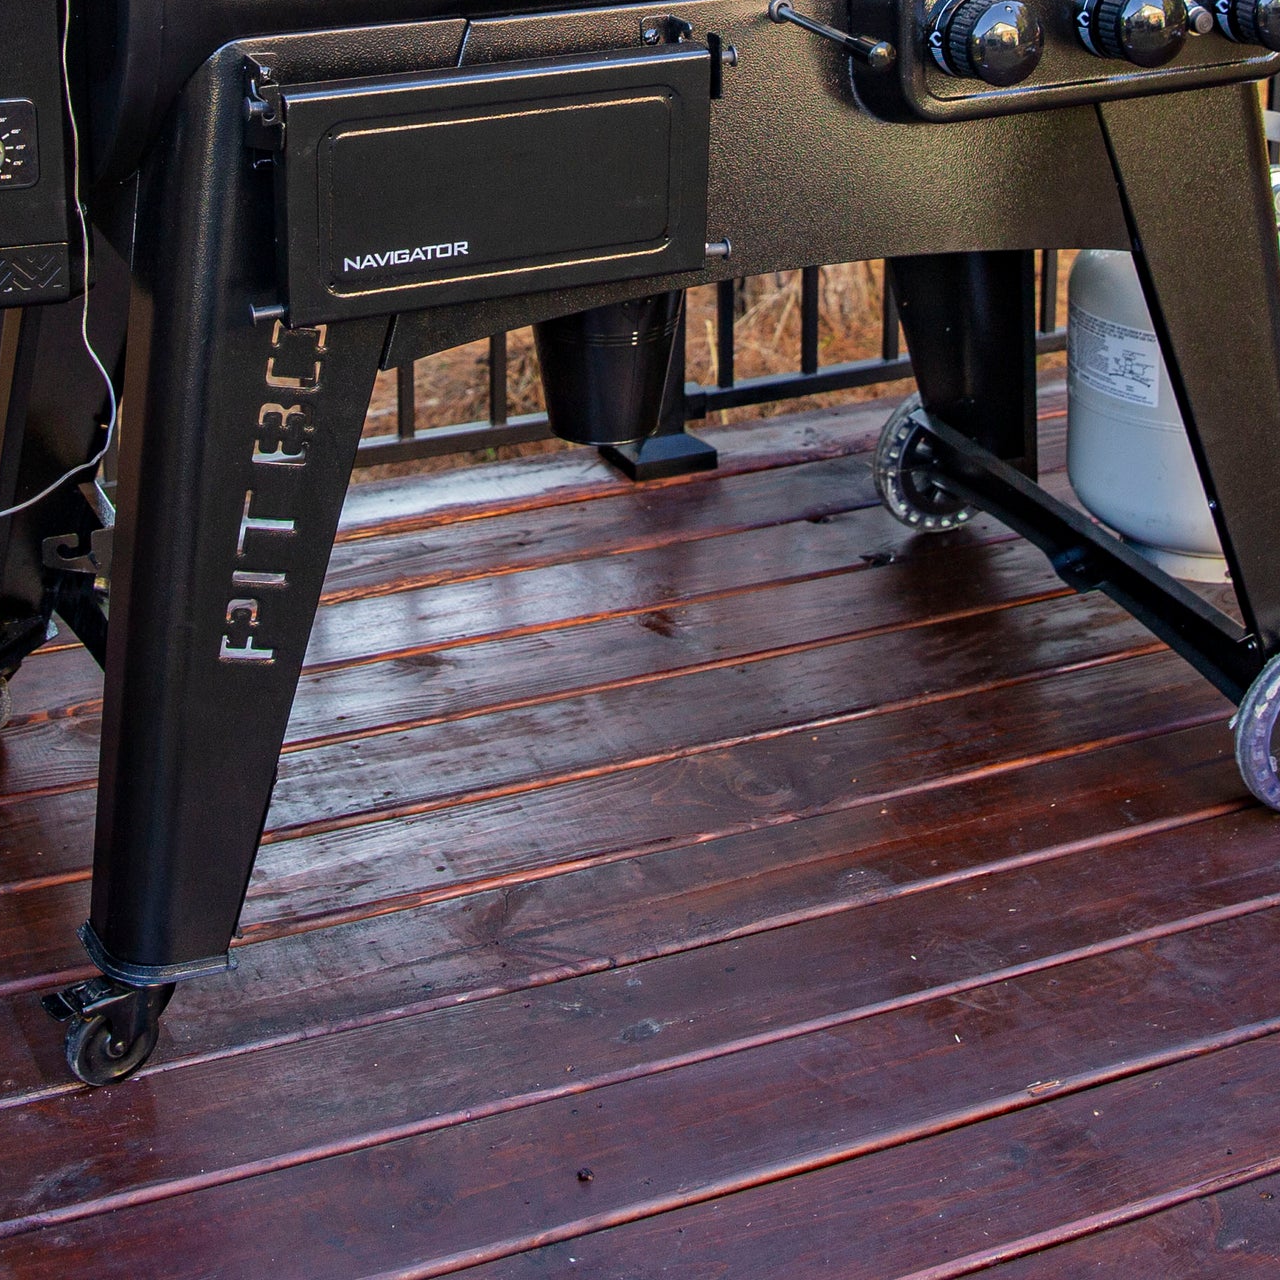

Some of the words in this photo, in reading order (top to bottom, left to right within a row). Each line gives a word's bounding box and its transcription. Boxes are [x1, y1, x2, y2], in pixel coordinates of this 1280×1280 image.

[344, 241, 469, 272] NAVIGATOR
[251, 319, 328, 467] BO
[218, 489, 296, 664] PIT
